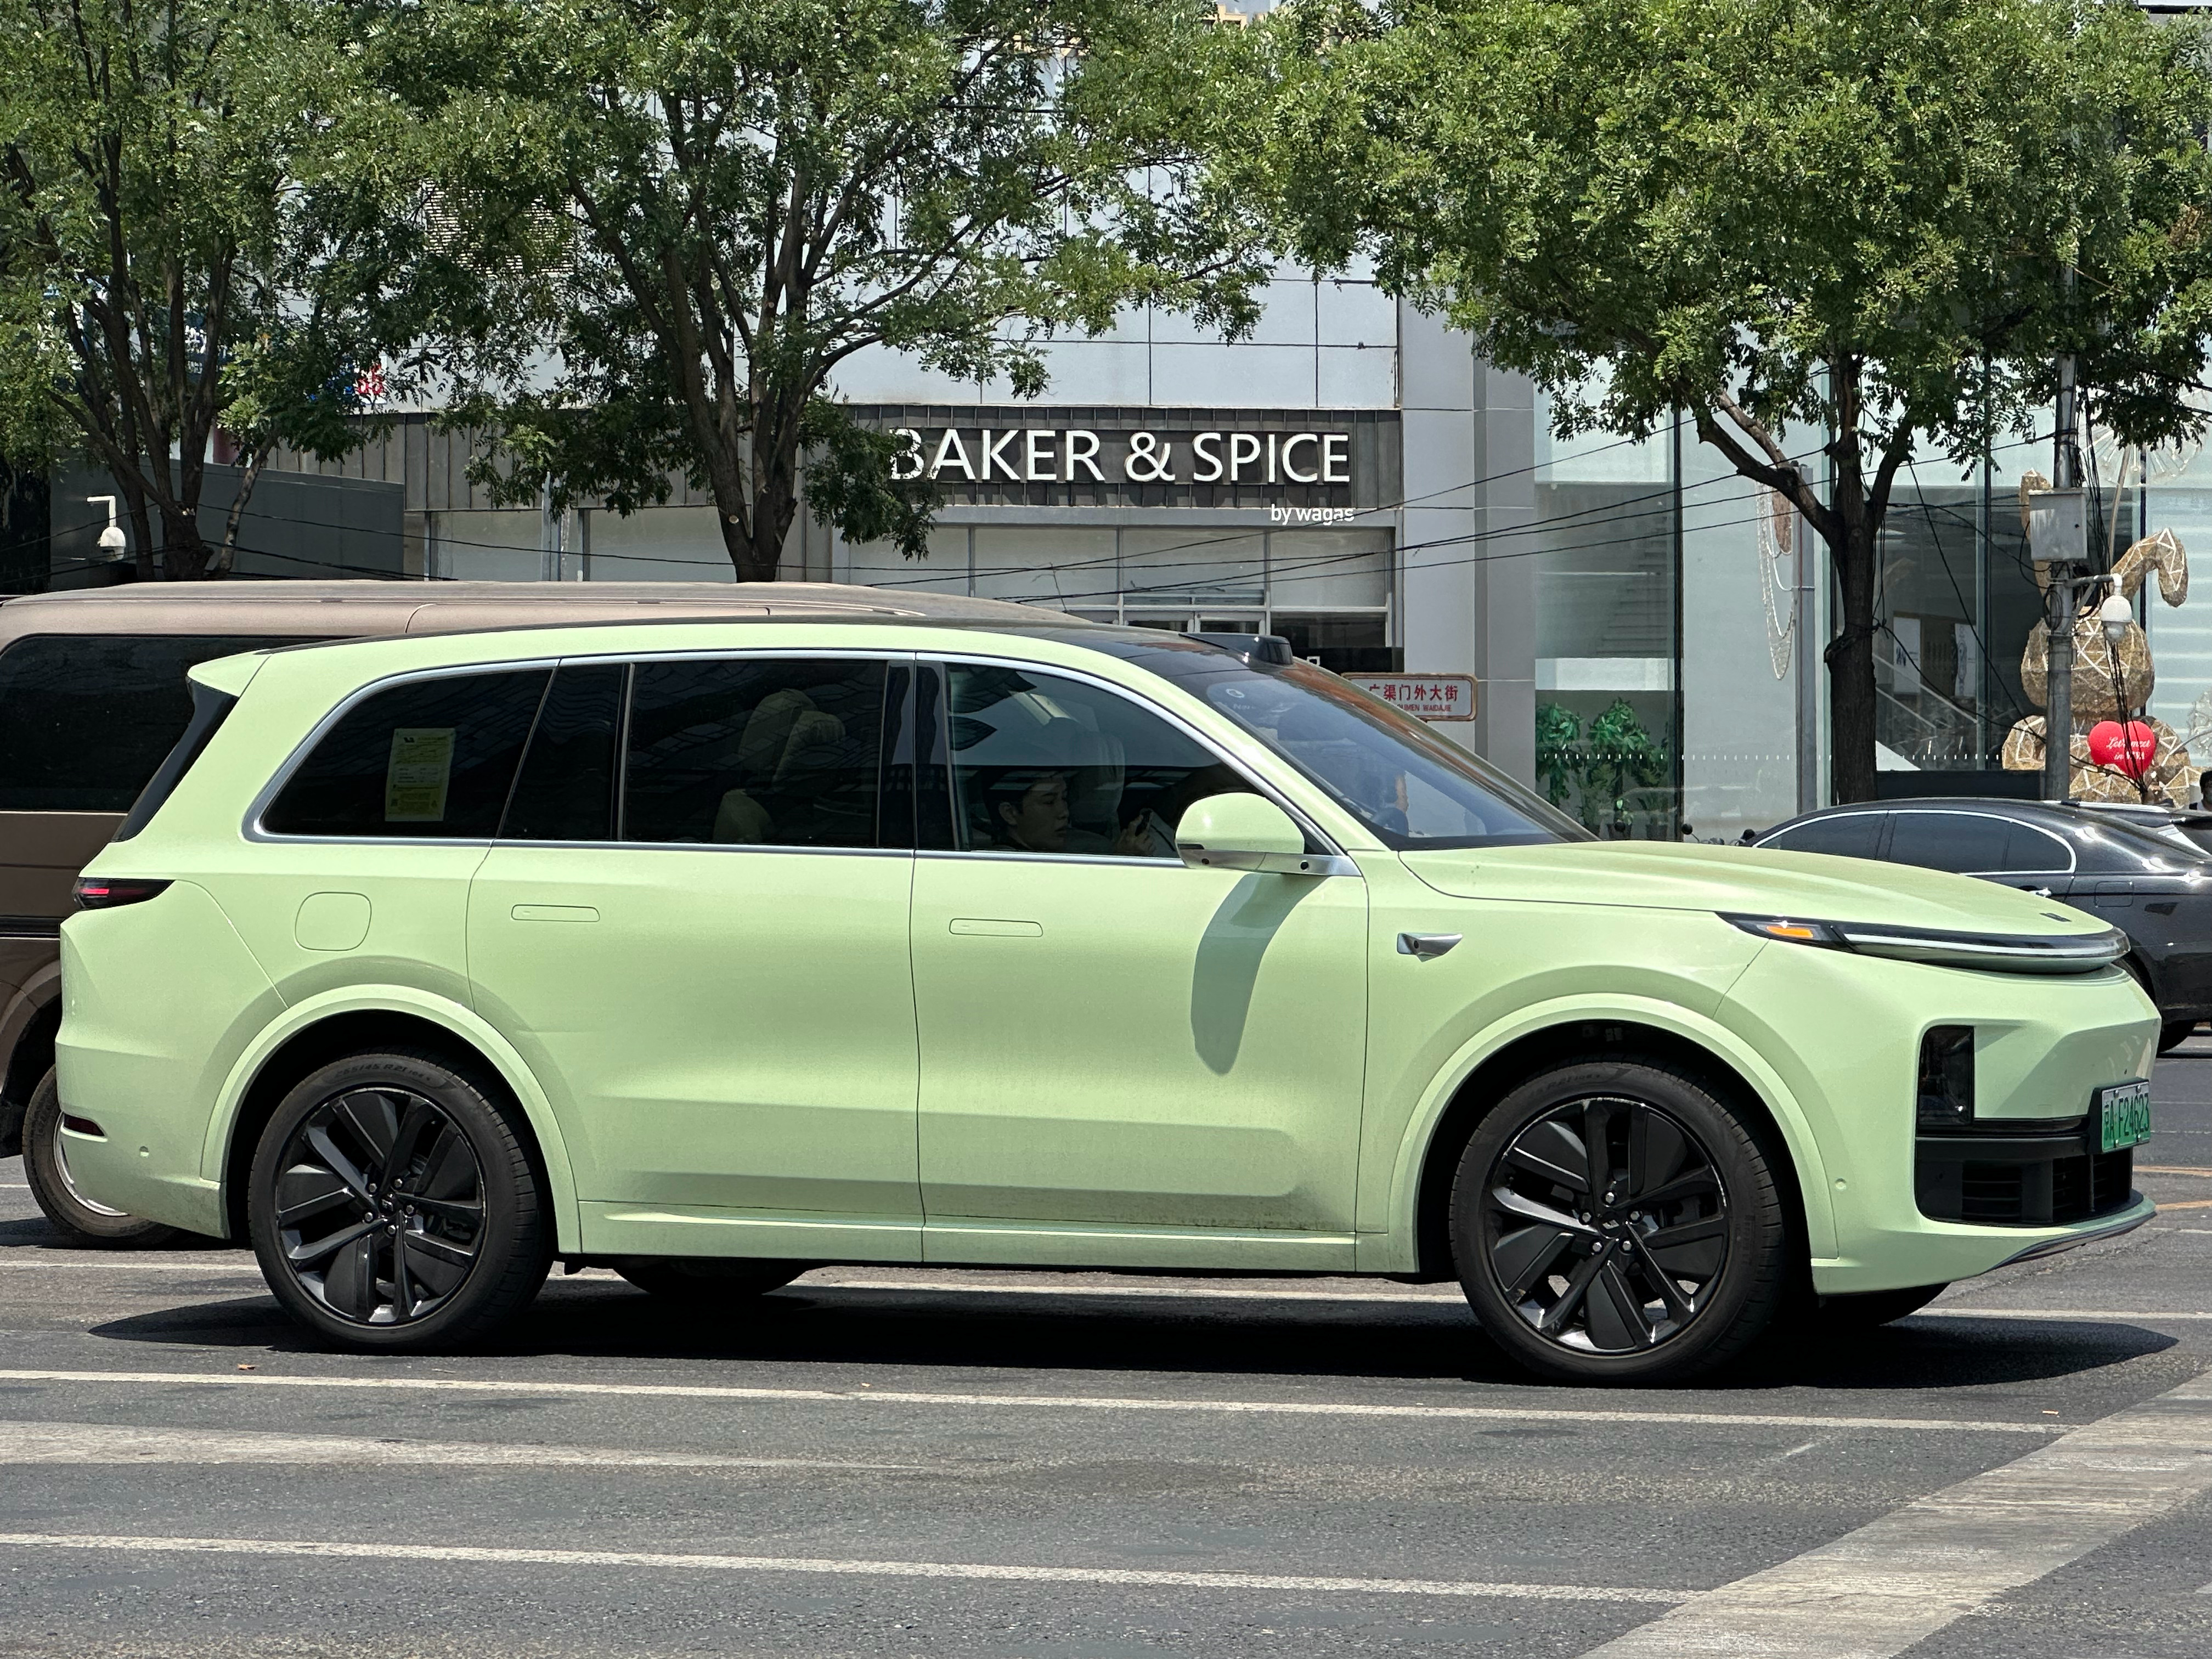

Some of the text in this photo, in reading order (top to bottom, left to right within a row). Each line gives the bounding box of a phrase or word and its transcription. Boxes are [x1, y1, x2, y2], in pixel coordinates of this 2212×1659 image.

[889, 428, 1350, 483] BAKER & SPICE
[1271, 503, 1355, 526] by wagas
